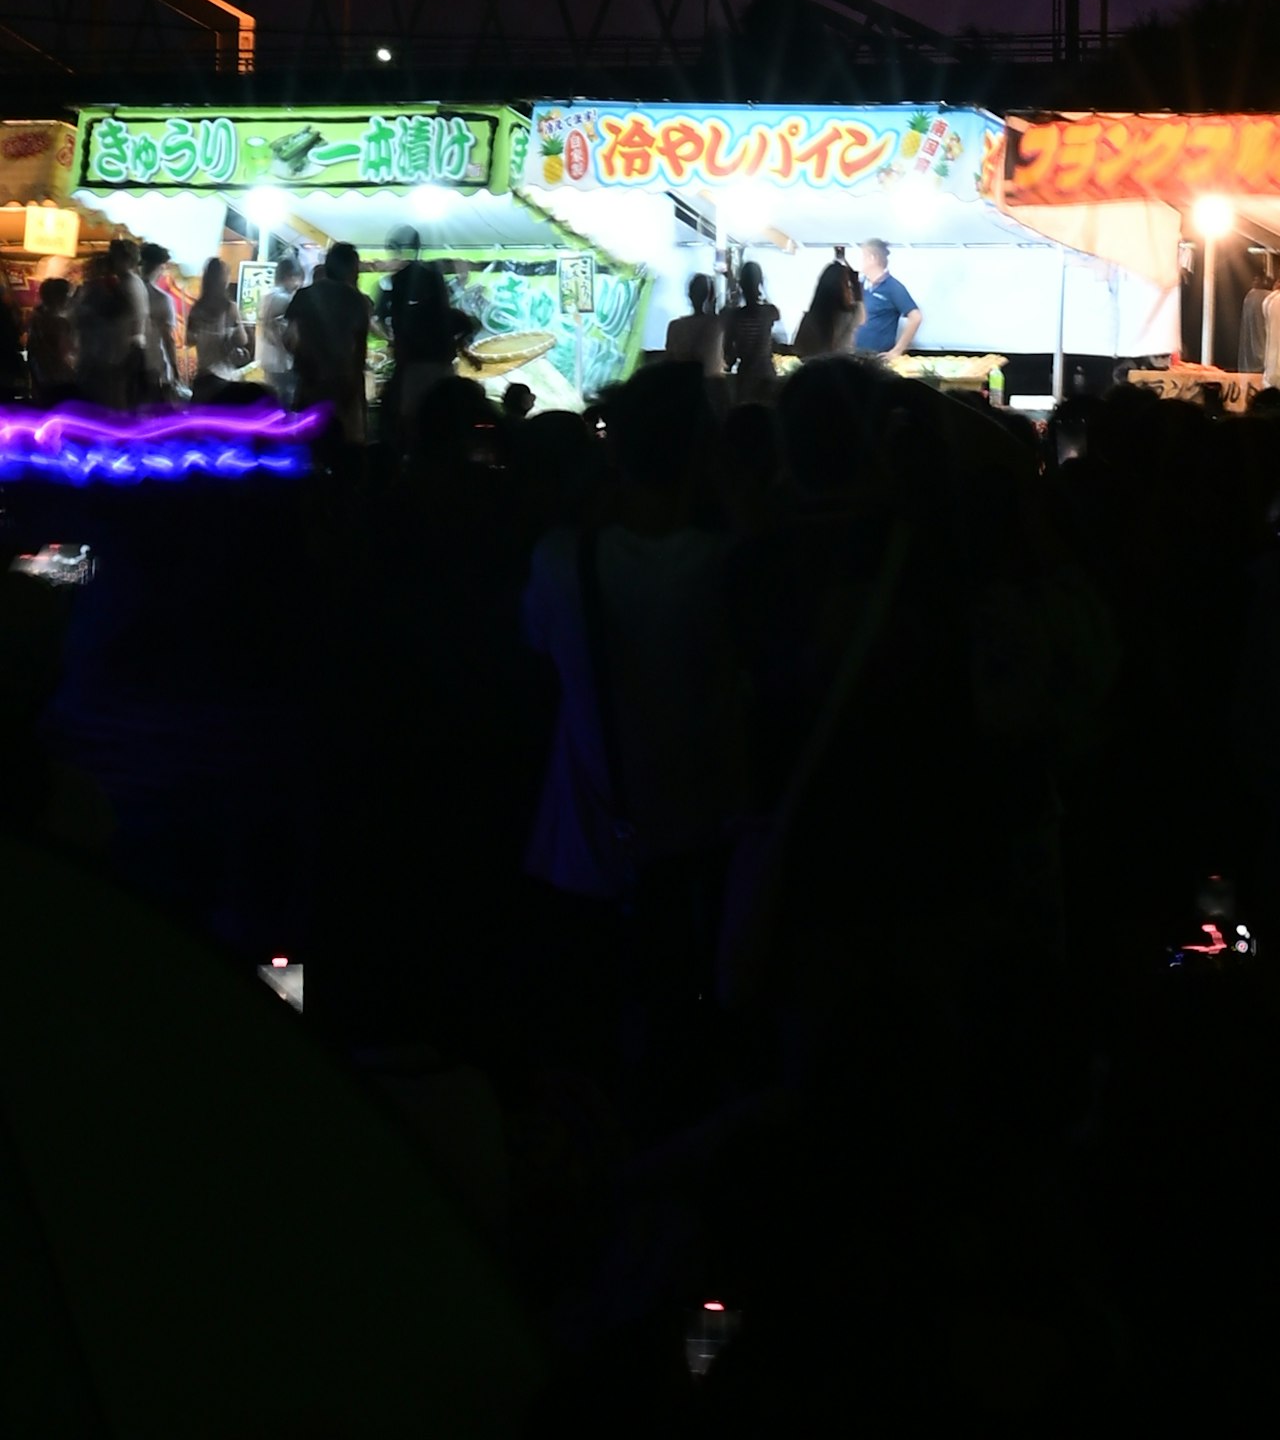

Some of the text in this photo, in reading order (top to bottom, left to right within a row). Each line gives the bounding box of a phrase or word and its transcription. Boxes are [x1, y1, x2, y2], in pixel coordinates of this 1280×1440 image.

[95, 118, 239, 181] きゅうり
[309, 117, 475, 180] 一本漬け
[601, 117, 896, 179] 冷やしパイン
